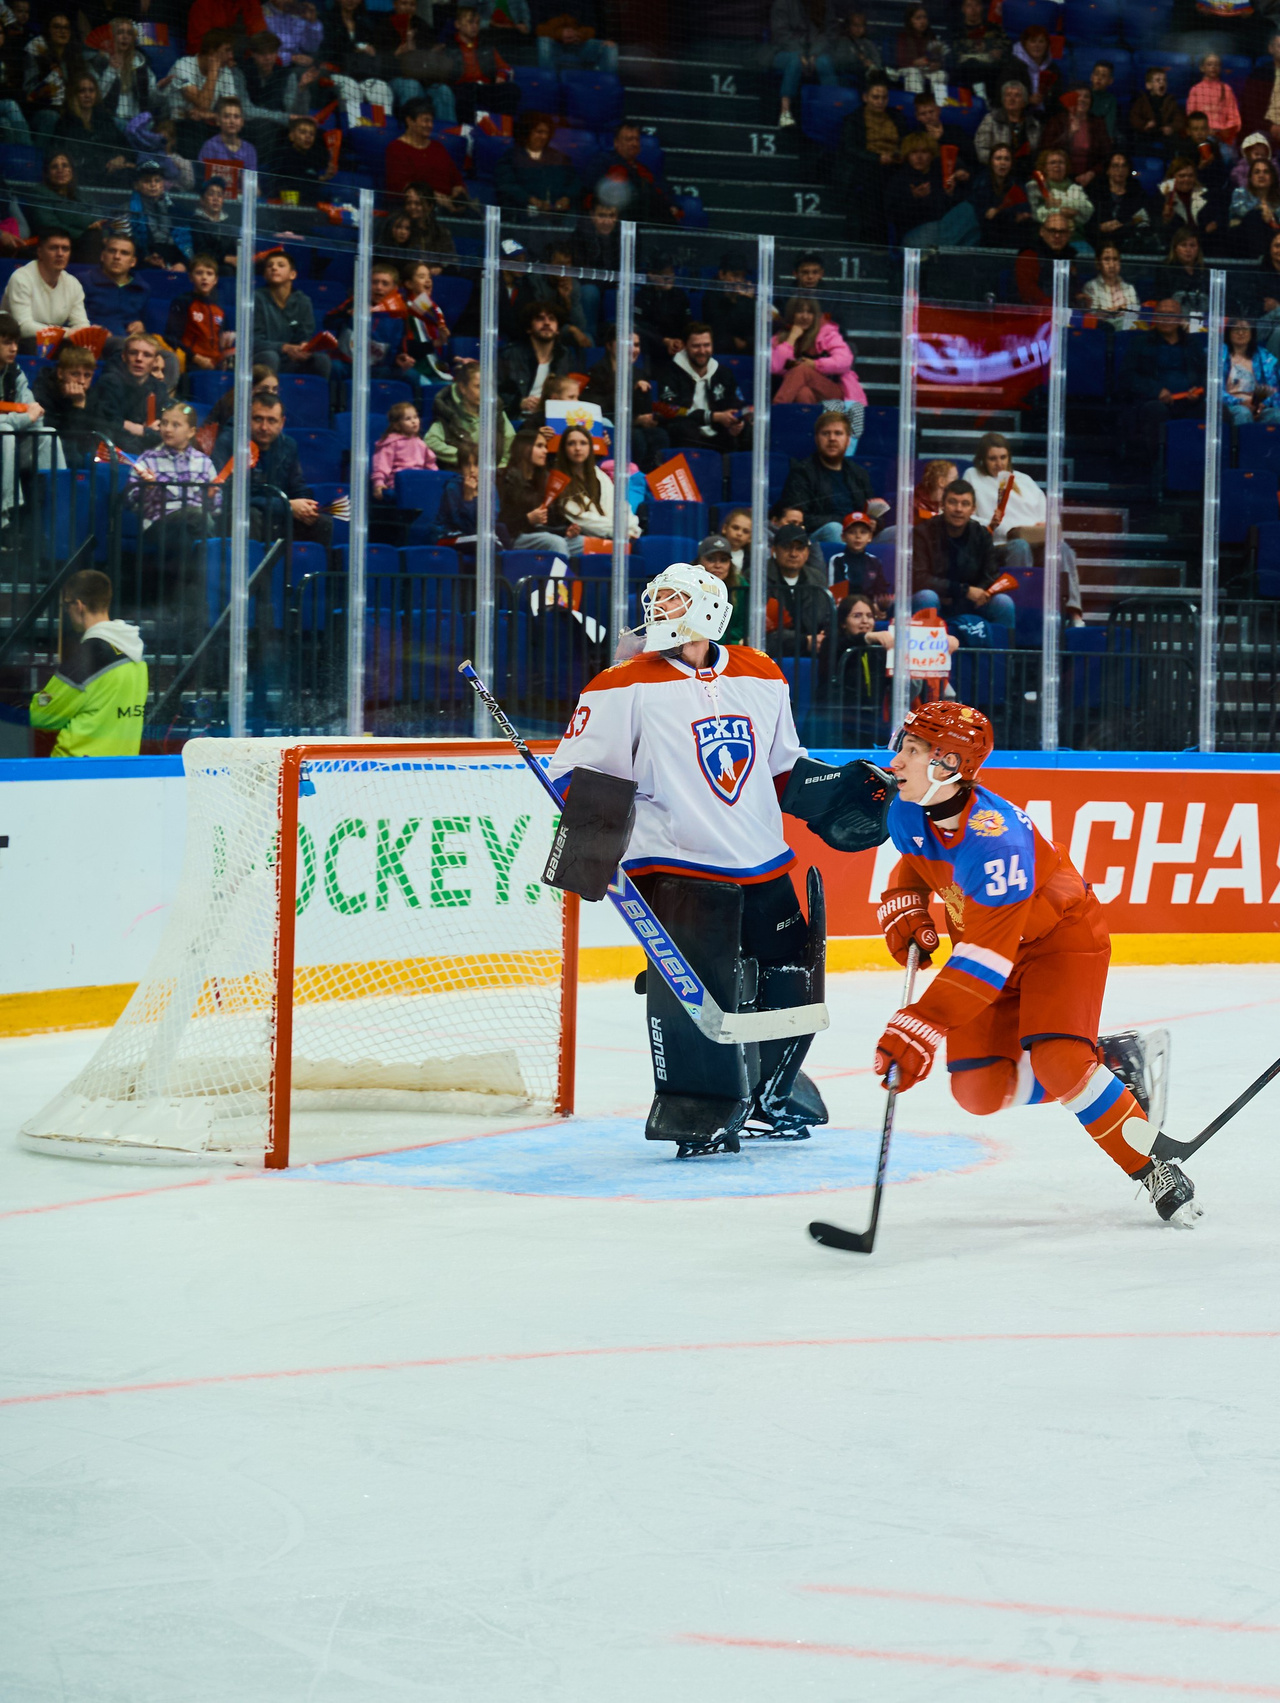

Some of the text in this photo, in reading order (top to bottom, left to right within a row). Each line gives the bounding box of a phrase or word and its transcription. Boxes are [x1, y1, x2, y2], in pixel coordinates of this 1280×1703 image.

[710, 74, 737, 95] 14
[749, 133, 776, 155] 13
[793, 192, 821, 215] 12
[839, 257, 861, 279] 11
[717, 605, 730, 634] BAUER
[469, 678, 529, 752] SHADOW
[696, 718, 751, 745] СХЛ
[804, 771, 841, 785] BAUER
[545, 823, 570, 882] BAUER
[985, 853, 1028, 897] 34
[620, 900, 699, 997] BAUER
[651, 1016, 668, 1082] BAUER
